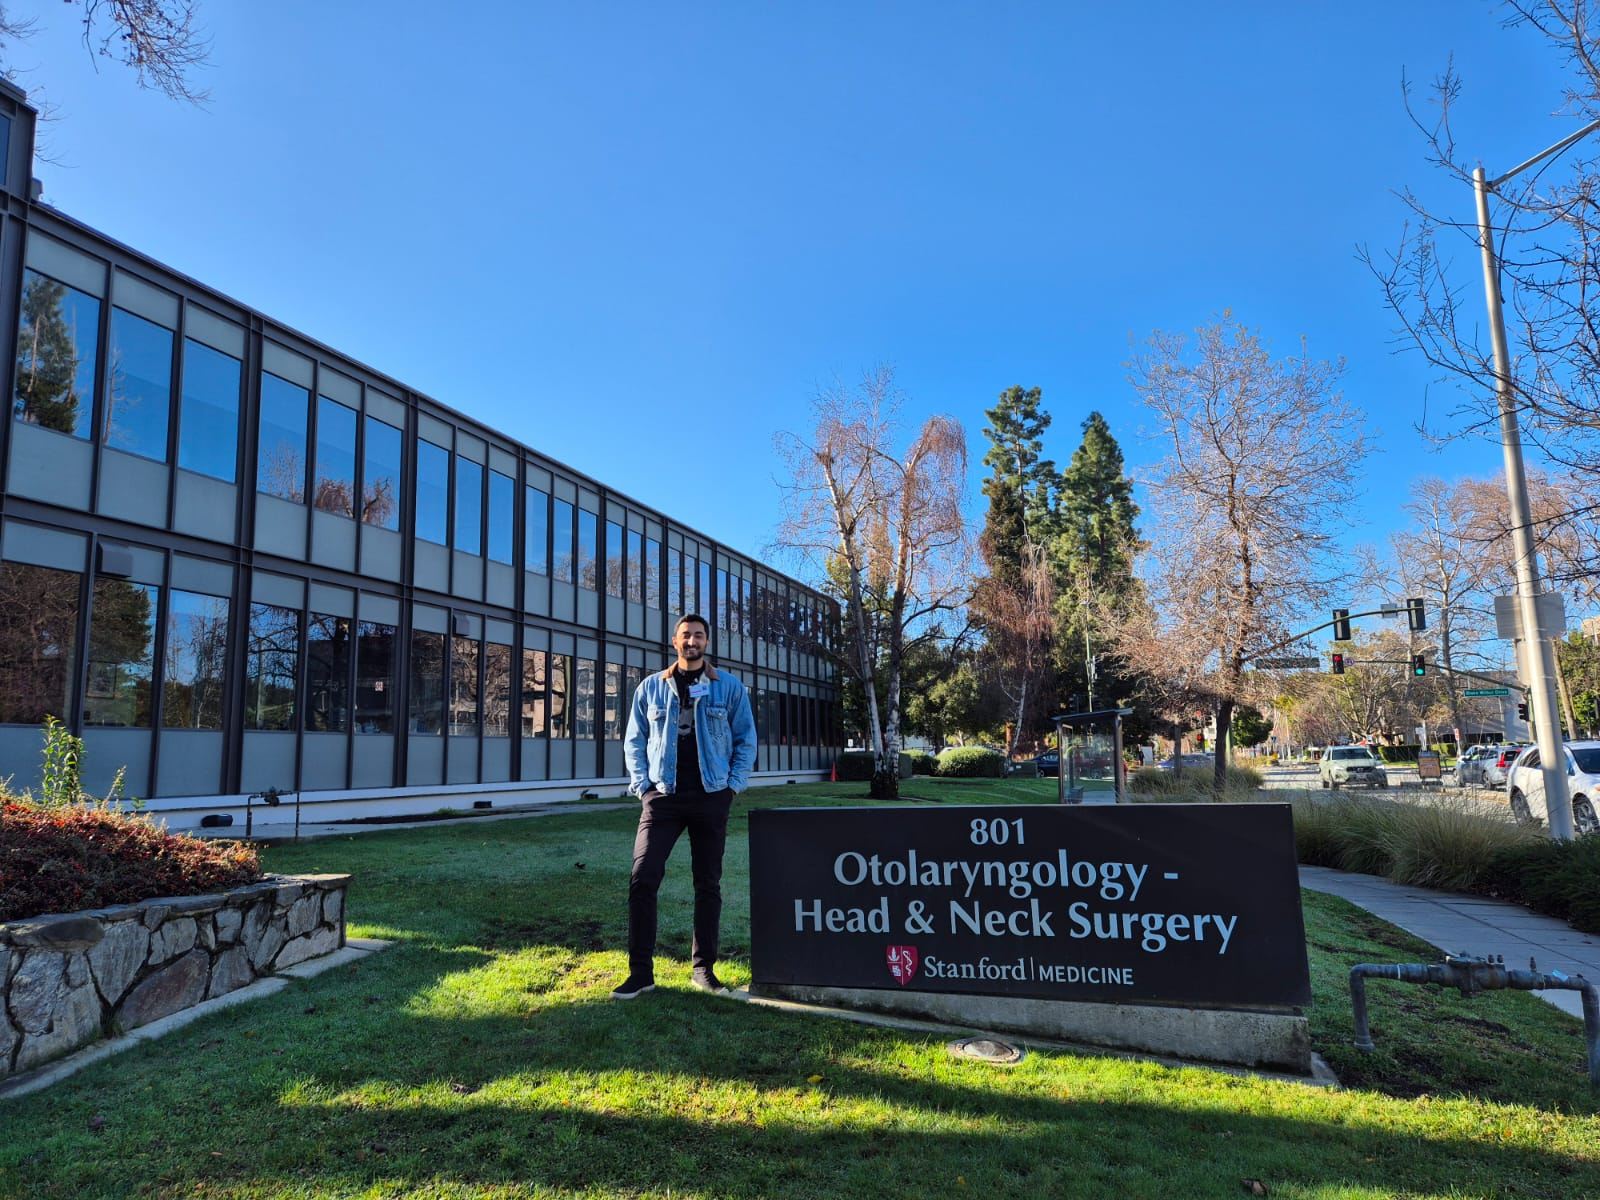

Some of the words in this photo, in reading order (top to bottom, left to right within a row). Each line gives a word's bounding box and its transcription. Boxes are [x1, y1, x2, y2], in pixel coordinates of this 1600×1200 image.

[970, 817, 1025, 845] 801
[834, 849, 1148, 901] Otolaryngology
[794, 898, 890, 934] Head
[904, 900, 935, 934] &
[950, 899, 1055, 937] Neck
[1068, 902, 1238, 955] Surgery
[924, 956, 1026, 981] Stanford
[1038, 965, 1134, 985] MEDICINE
